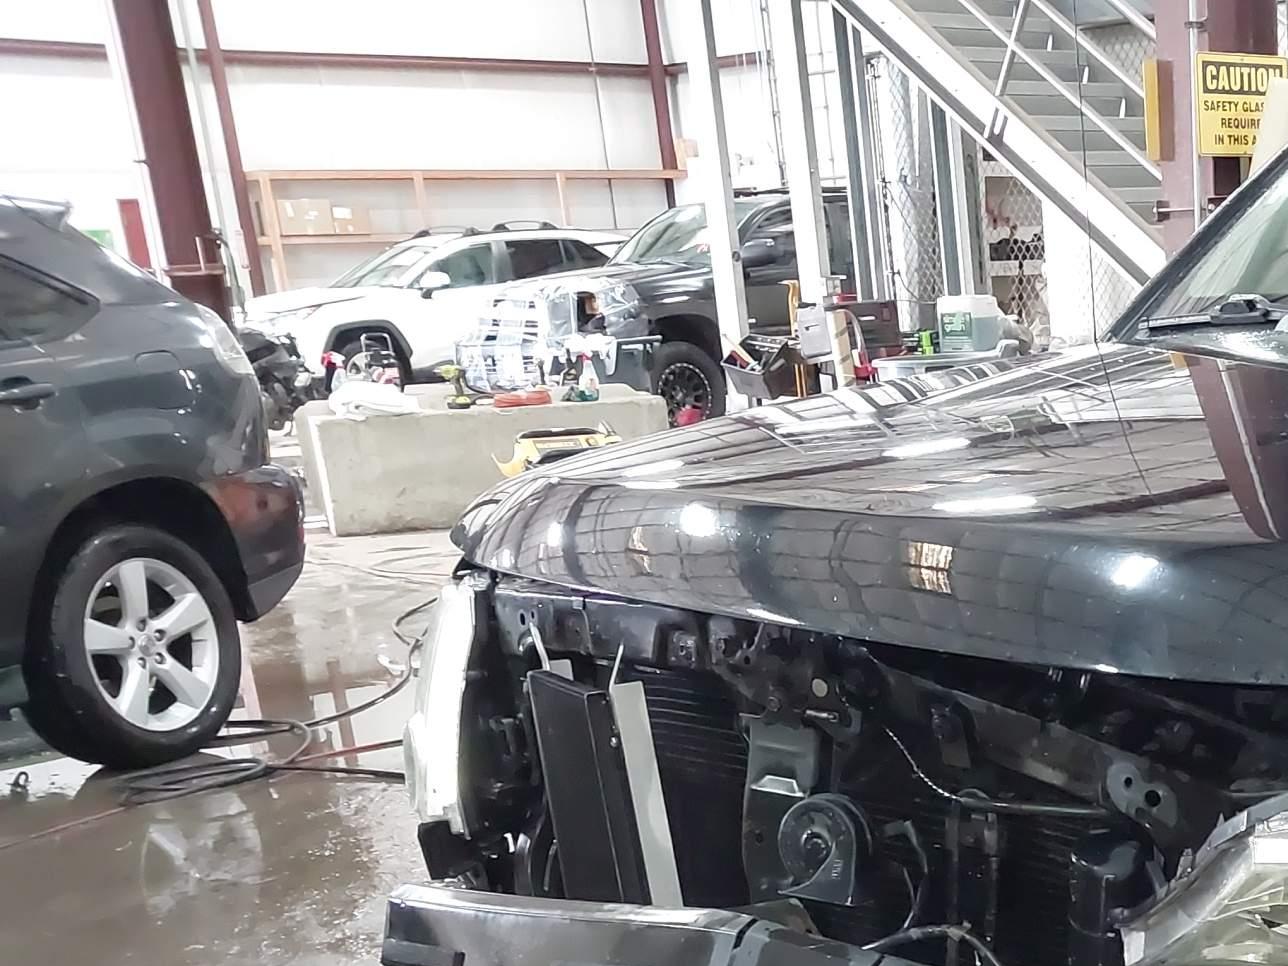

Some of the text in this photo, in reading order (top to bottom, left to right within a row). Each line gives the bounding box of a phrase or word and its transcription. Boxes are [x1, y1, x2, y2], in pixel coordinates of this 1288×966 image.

[1203, 100, 1239, 112] SAFETY
[1214, 134, 1225, 145] IN
[1227, 134, 1249, 145] THIS
